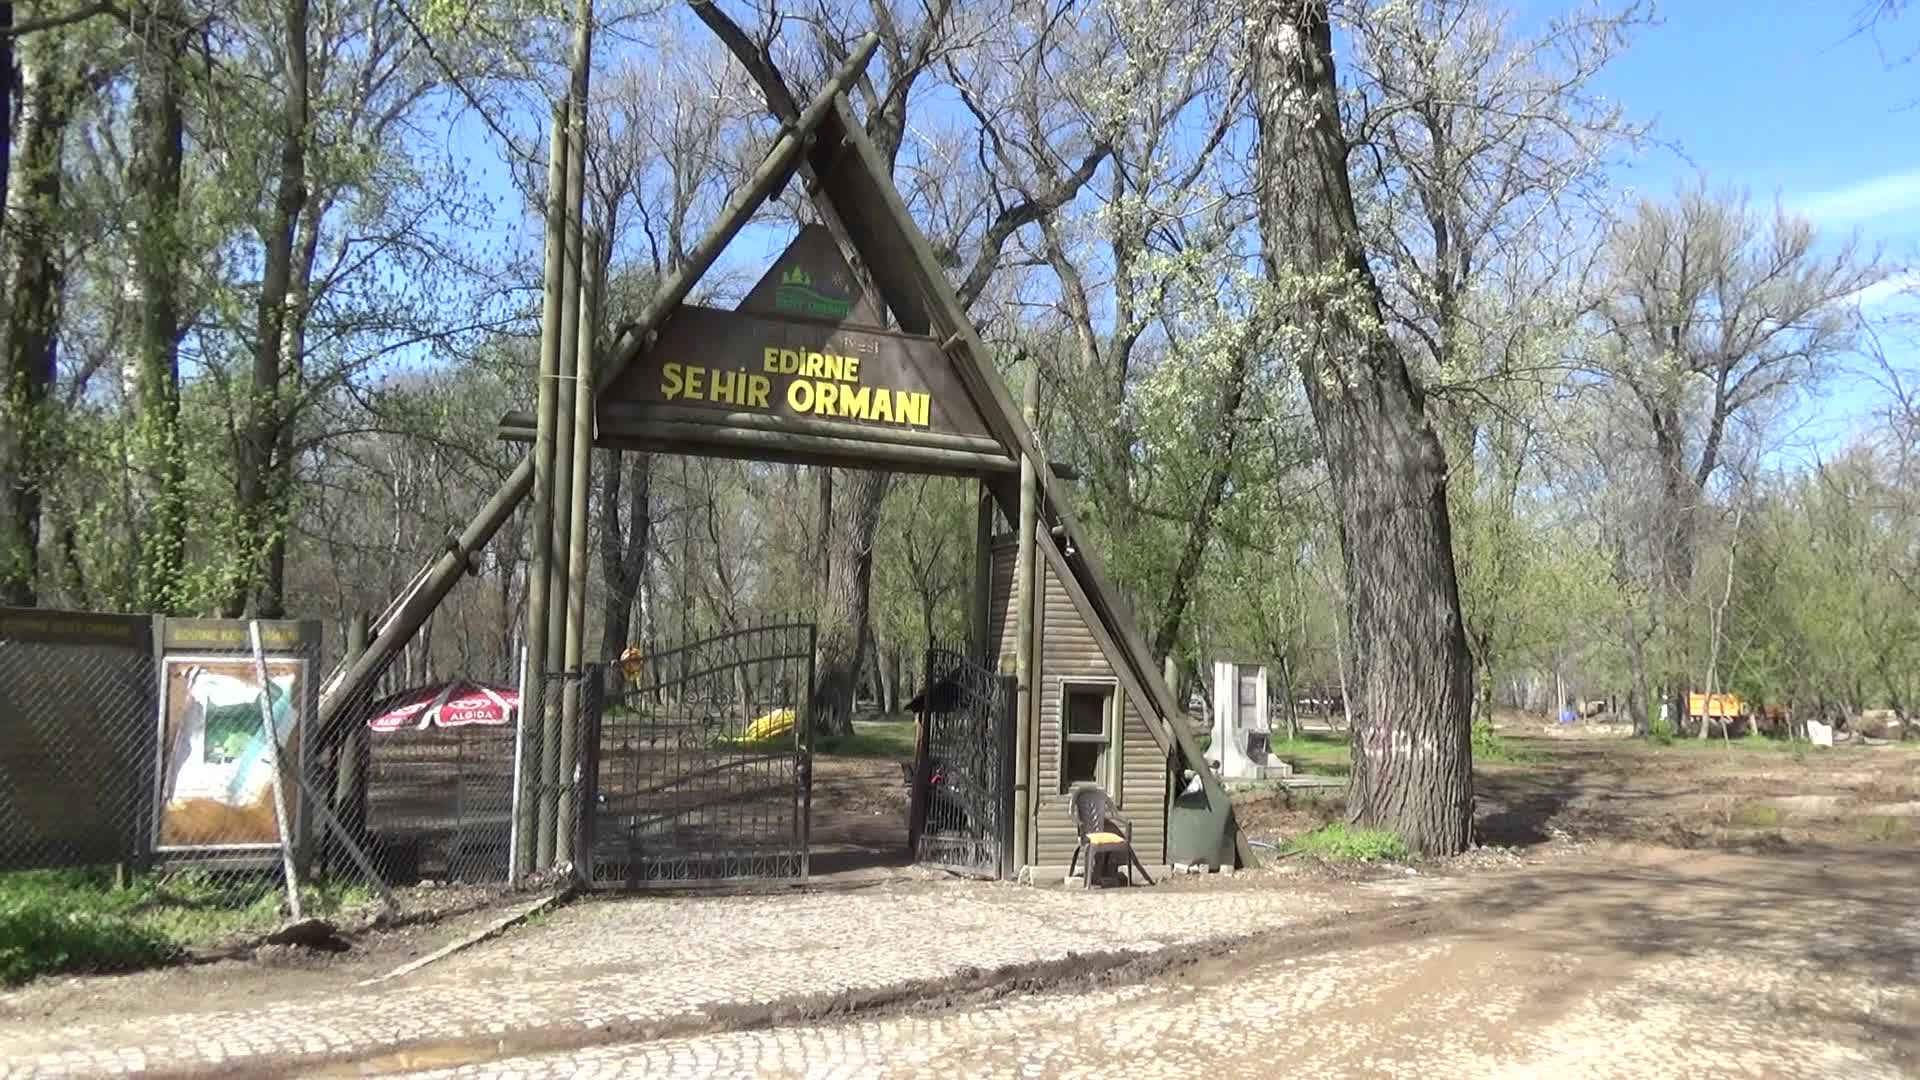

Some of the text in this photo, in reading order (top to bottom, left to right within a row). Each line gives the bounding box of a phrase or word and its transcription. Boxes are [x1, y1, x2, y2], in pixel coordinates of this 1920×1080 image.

[763, 346, 860, 382] EDİRNE
[660, 362, 931, 426] ŞEHİR ORMANI
[450, 710, 493, 721] ALGIDA
